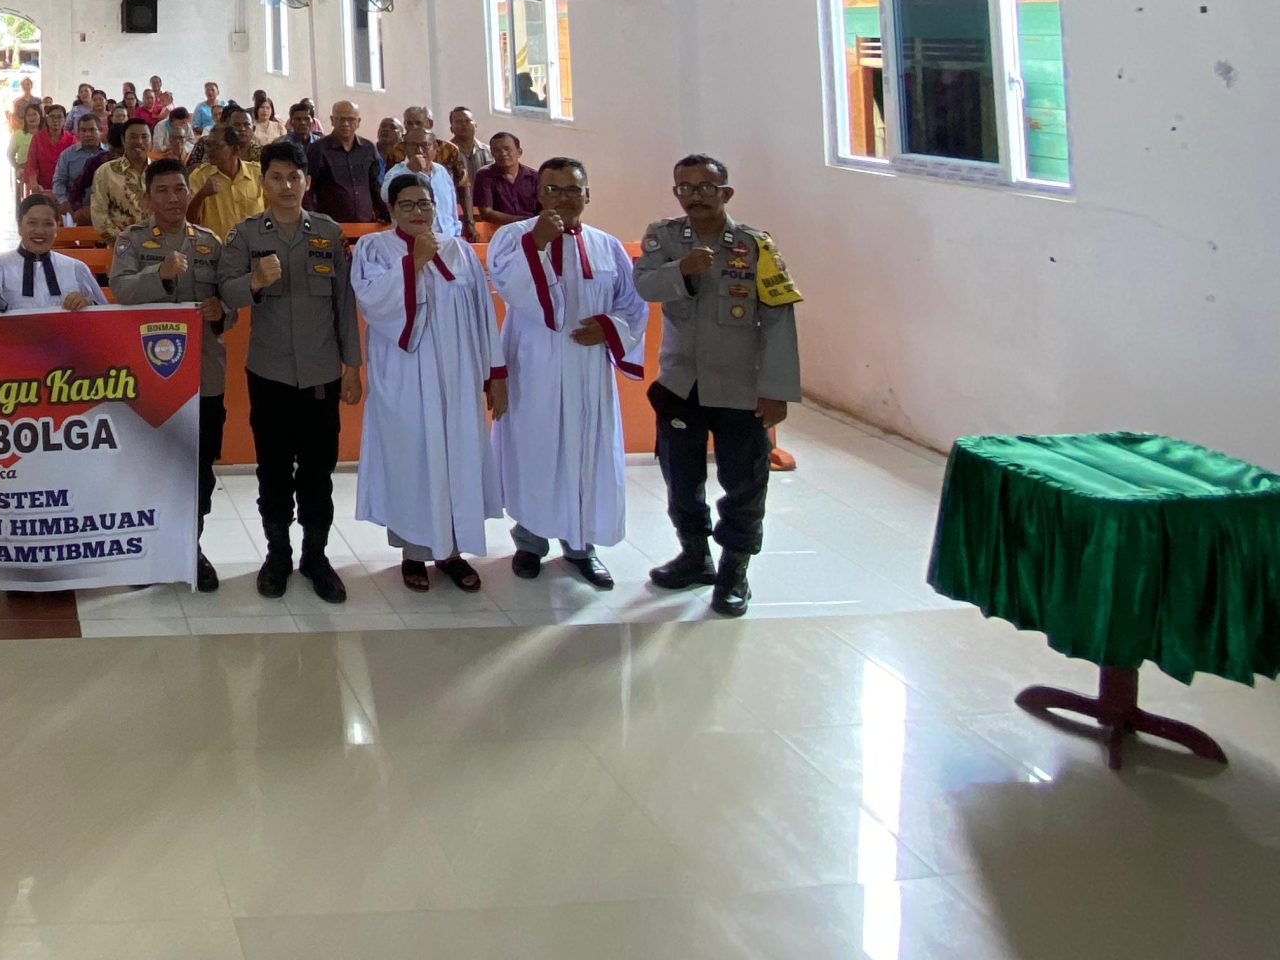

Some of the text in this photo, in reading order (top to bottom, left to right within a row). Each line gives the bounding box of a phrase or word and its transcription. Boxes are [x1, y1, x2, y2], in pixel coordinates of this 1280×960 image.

[147, 323, 180, 333] BINMAS
[46, 368, 136, 403] Kasih
[9, 509, 156, 536] HIMBAUAN
